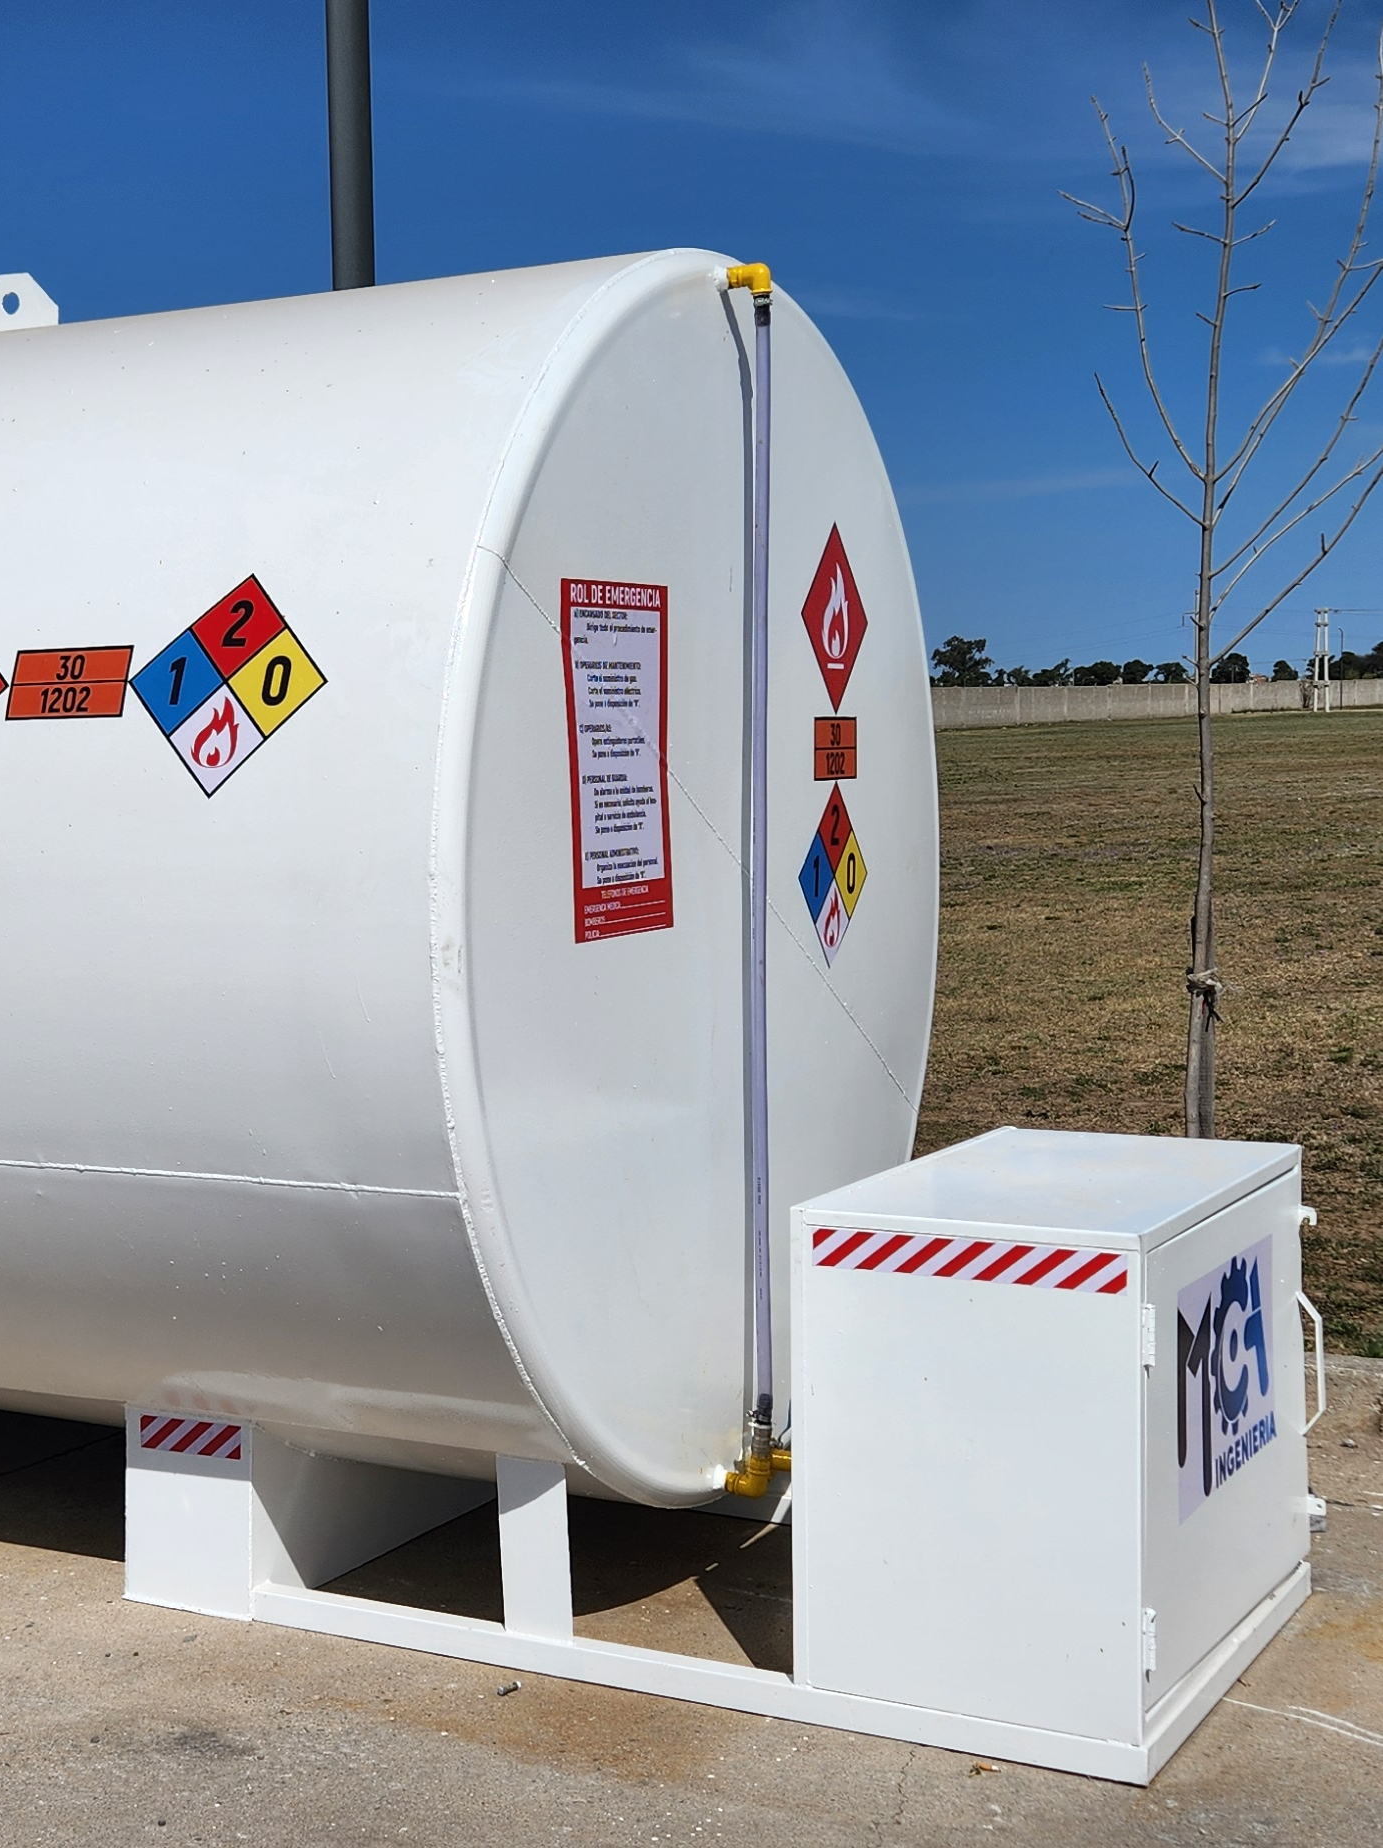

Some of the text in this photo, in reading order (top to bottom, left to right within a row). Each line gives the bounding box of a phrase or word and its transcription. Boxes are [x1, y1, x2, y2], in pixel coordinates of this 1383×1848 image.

[570, 583, 661, 607] ROL DE EMERGENCIA
[221, 599, 255, 647] 2
[56, 655, 85, 681] 30
[168, 655, 292, 706] 1 0
[39, 686, 91, 714] 1202
[829, 723, 841, 746] 30
[826, 752, 845, 776] 1202
[830, 804, 840, 846] 2
[812, 853, 856, 898] 1 0
[1215, 1411, 1277, 1490] INGENIERIA
